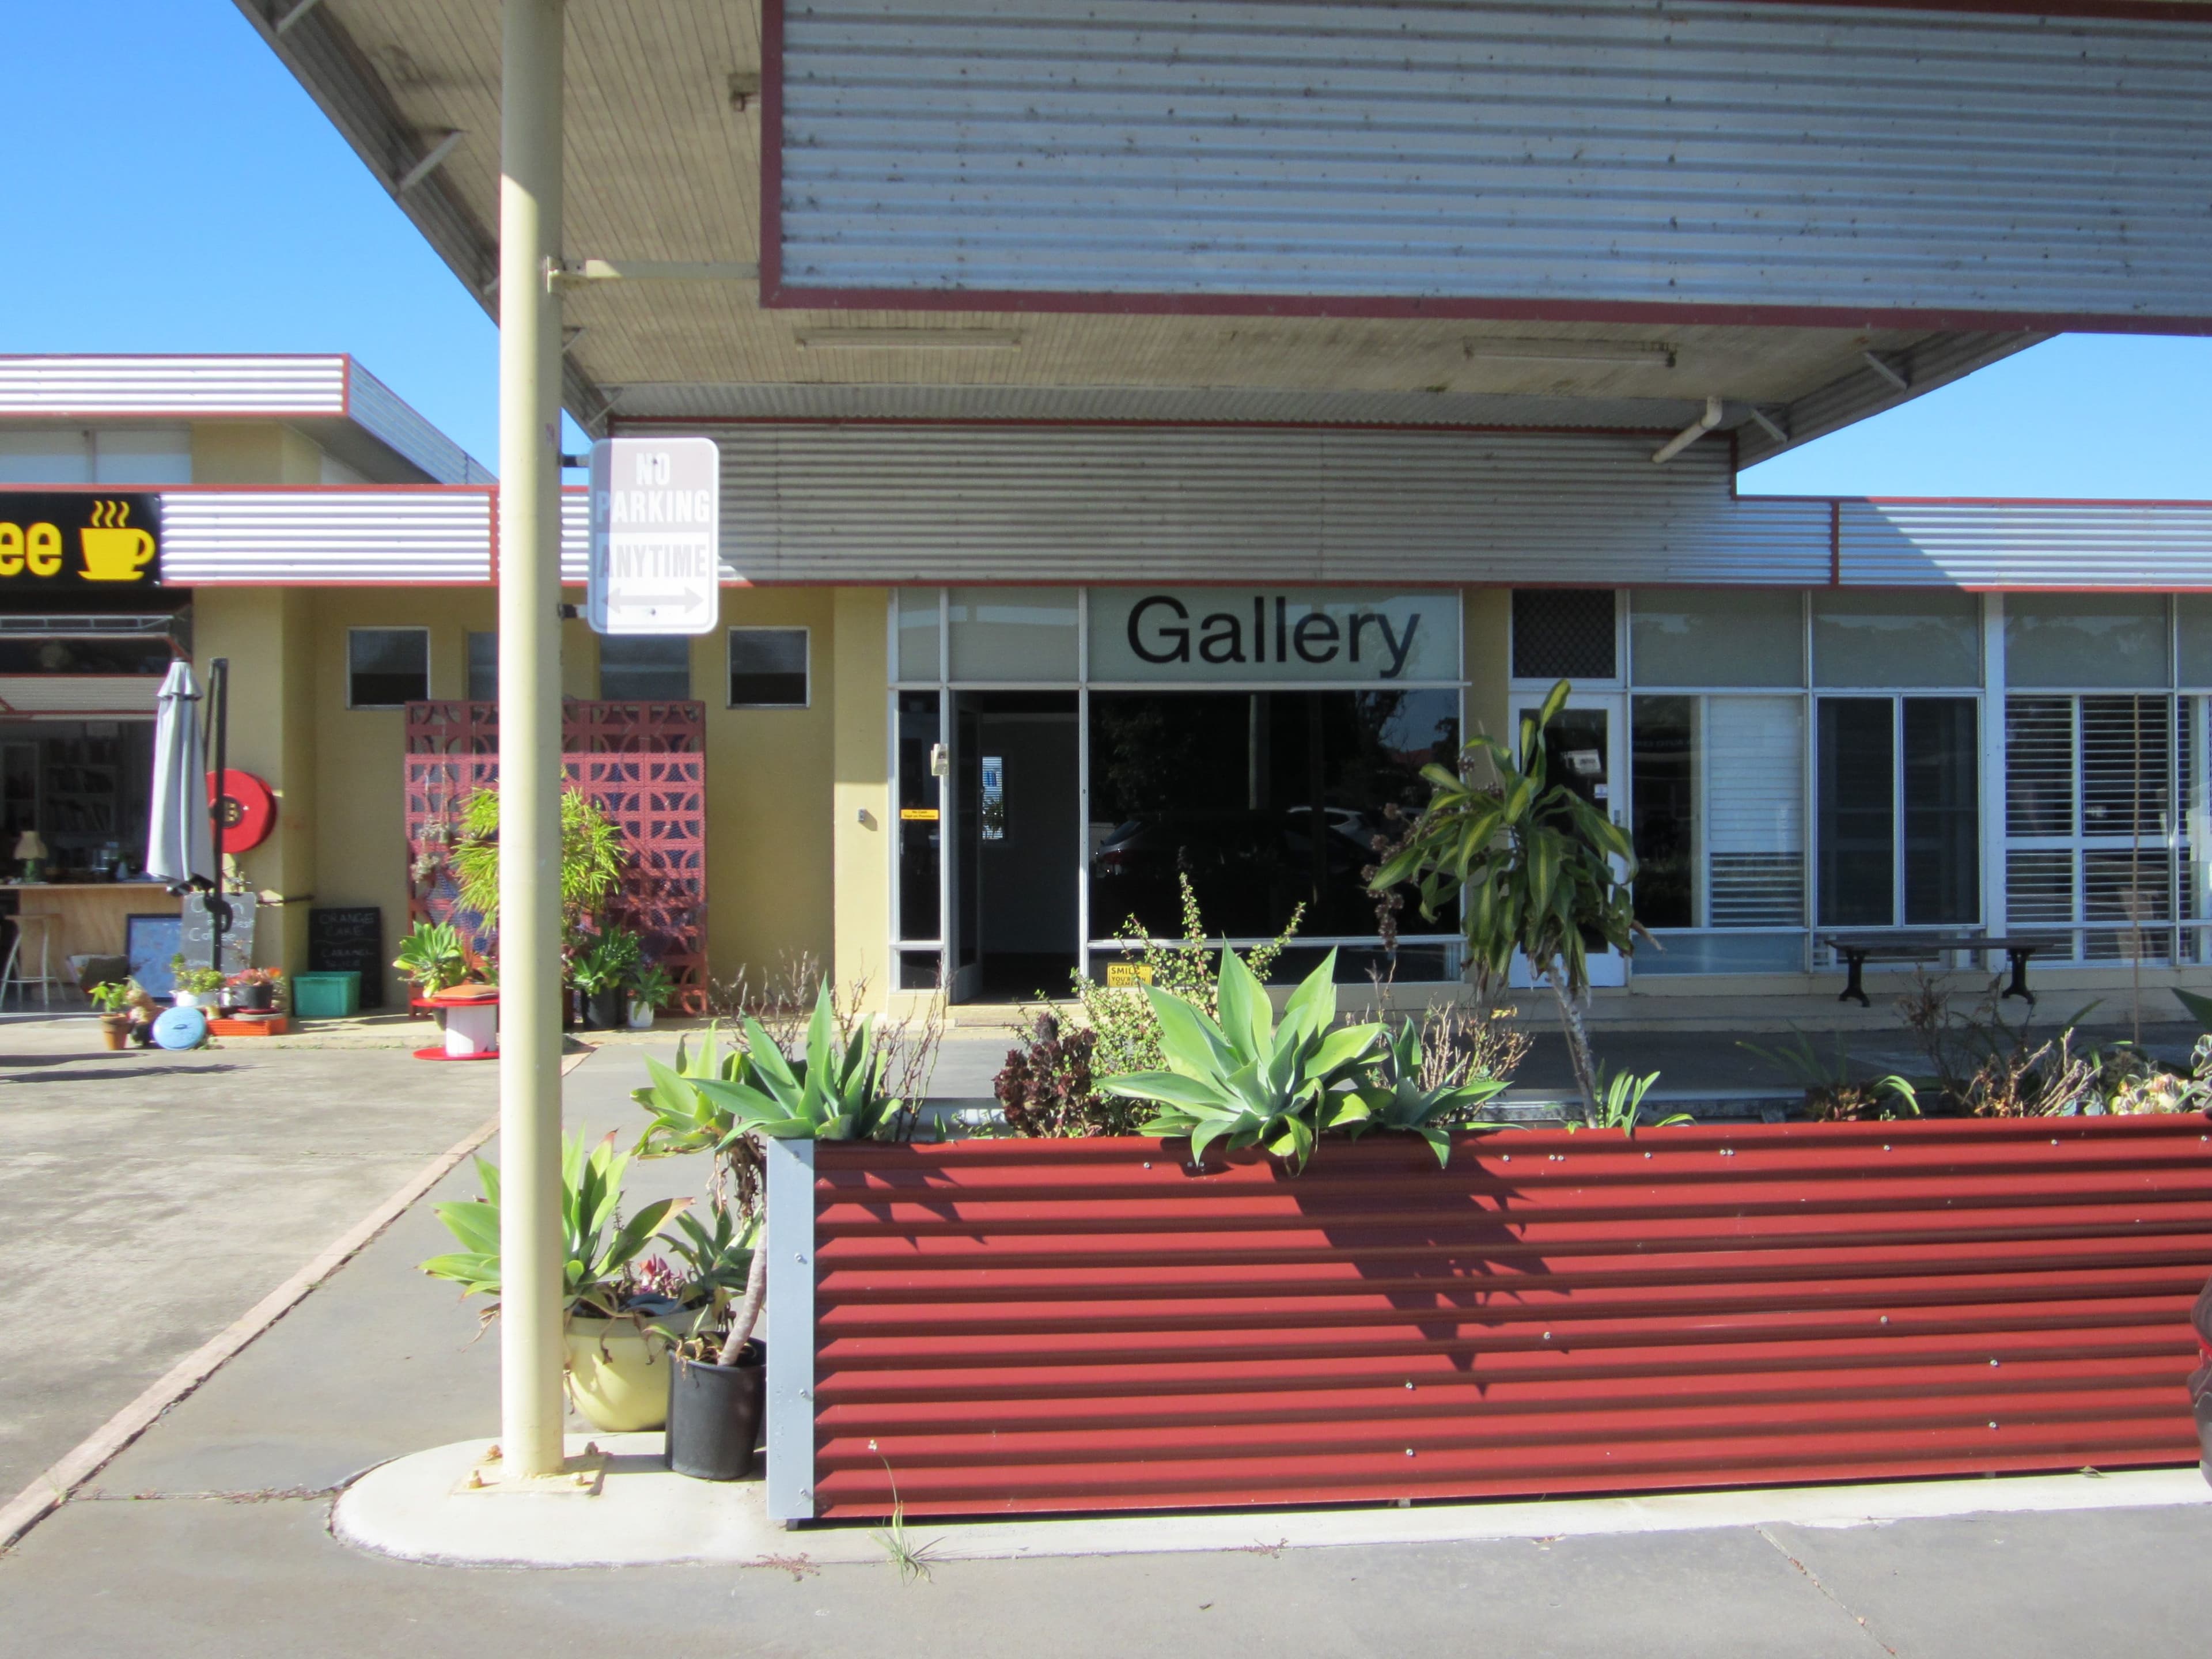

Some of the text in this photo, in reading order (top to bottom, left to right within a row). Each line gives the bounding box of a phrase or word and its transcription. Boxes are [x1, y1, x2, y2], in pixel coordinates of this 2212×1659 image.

[636, 453, 670, 485] NO
[596, 490, 710, 522] PARKING
[599, 544, 707, 578] ANYTIME
[1127, 595, 1421, 679] Gallery
[191, 895, 245, 916] On
[320, 912, 374, 925] ORANGE
[189, 927, 236, 941] Coee
